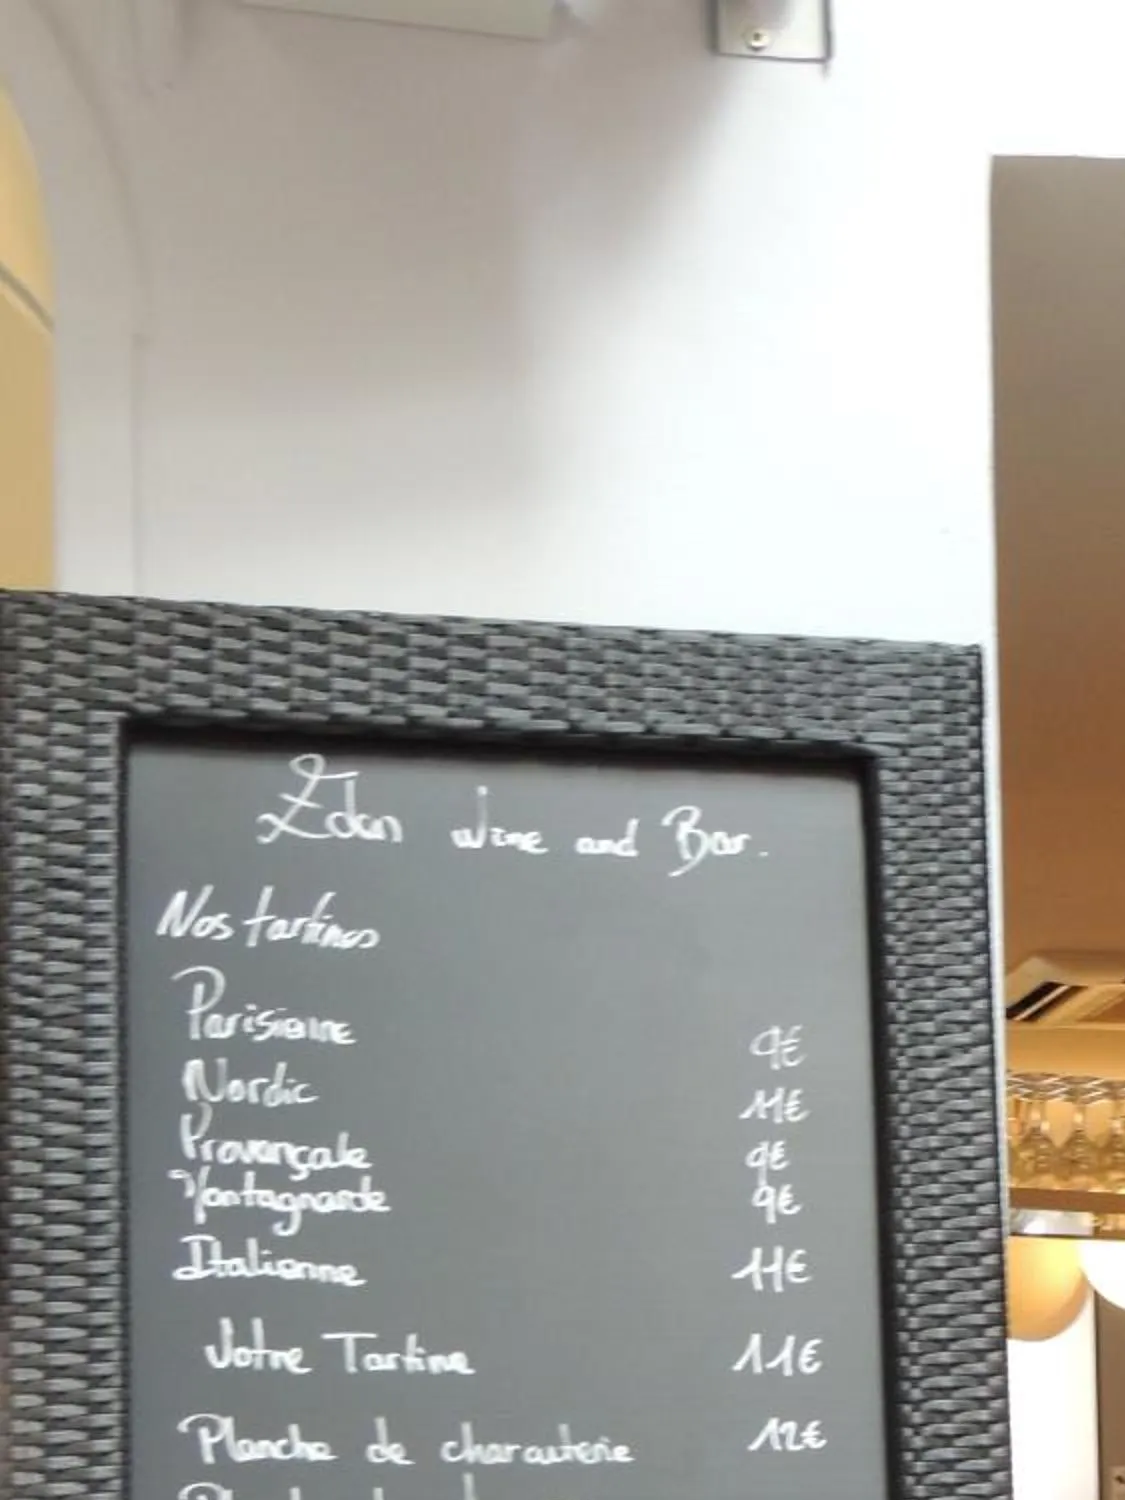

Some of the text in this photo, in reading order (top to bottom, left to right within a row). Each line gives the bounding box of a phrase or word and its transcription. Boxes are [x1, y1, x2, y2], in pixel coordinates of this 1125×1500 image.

[575, 819, 639, 857] and
[157, 884, 380, 948] Nos tartines
[172, 966, 805, 1070] Parisienne 9€
[182, 1058, 810, 1123] Nordic 11€
[180, 1102, 791, 1186] Provençale 9€
[169, 1170, 803, 1236] Montagnarde 9€
[172, 1234, 812, 1292] Italienne 11€
[205, 1316, 824, 1377] Votre Tartine 11€
[177, 1412, 339, 1464] Planche
[366, 1416, 414, 1466] de
[747, 1416, 827, 1452] 12€
